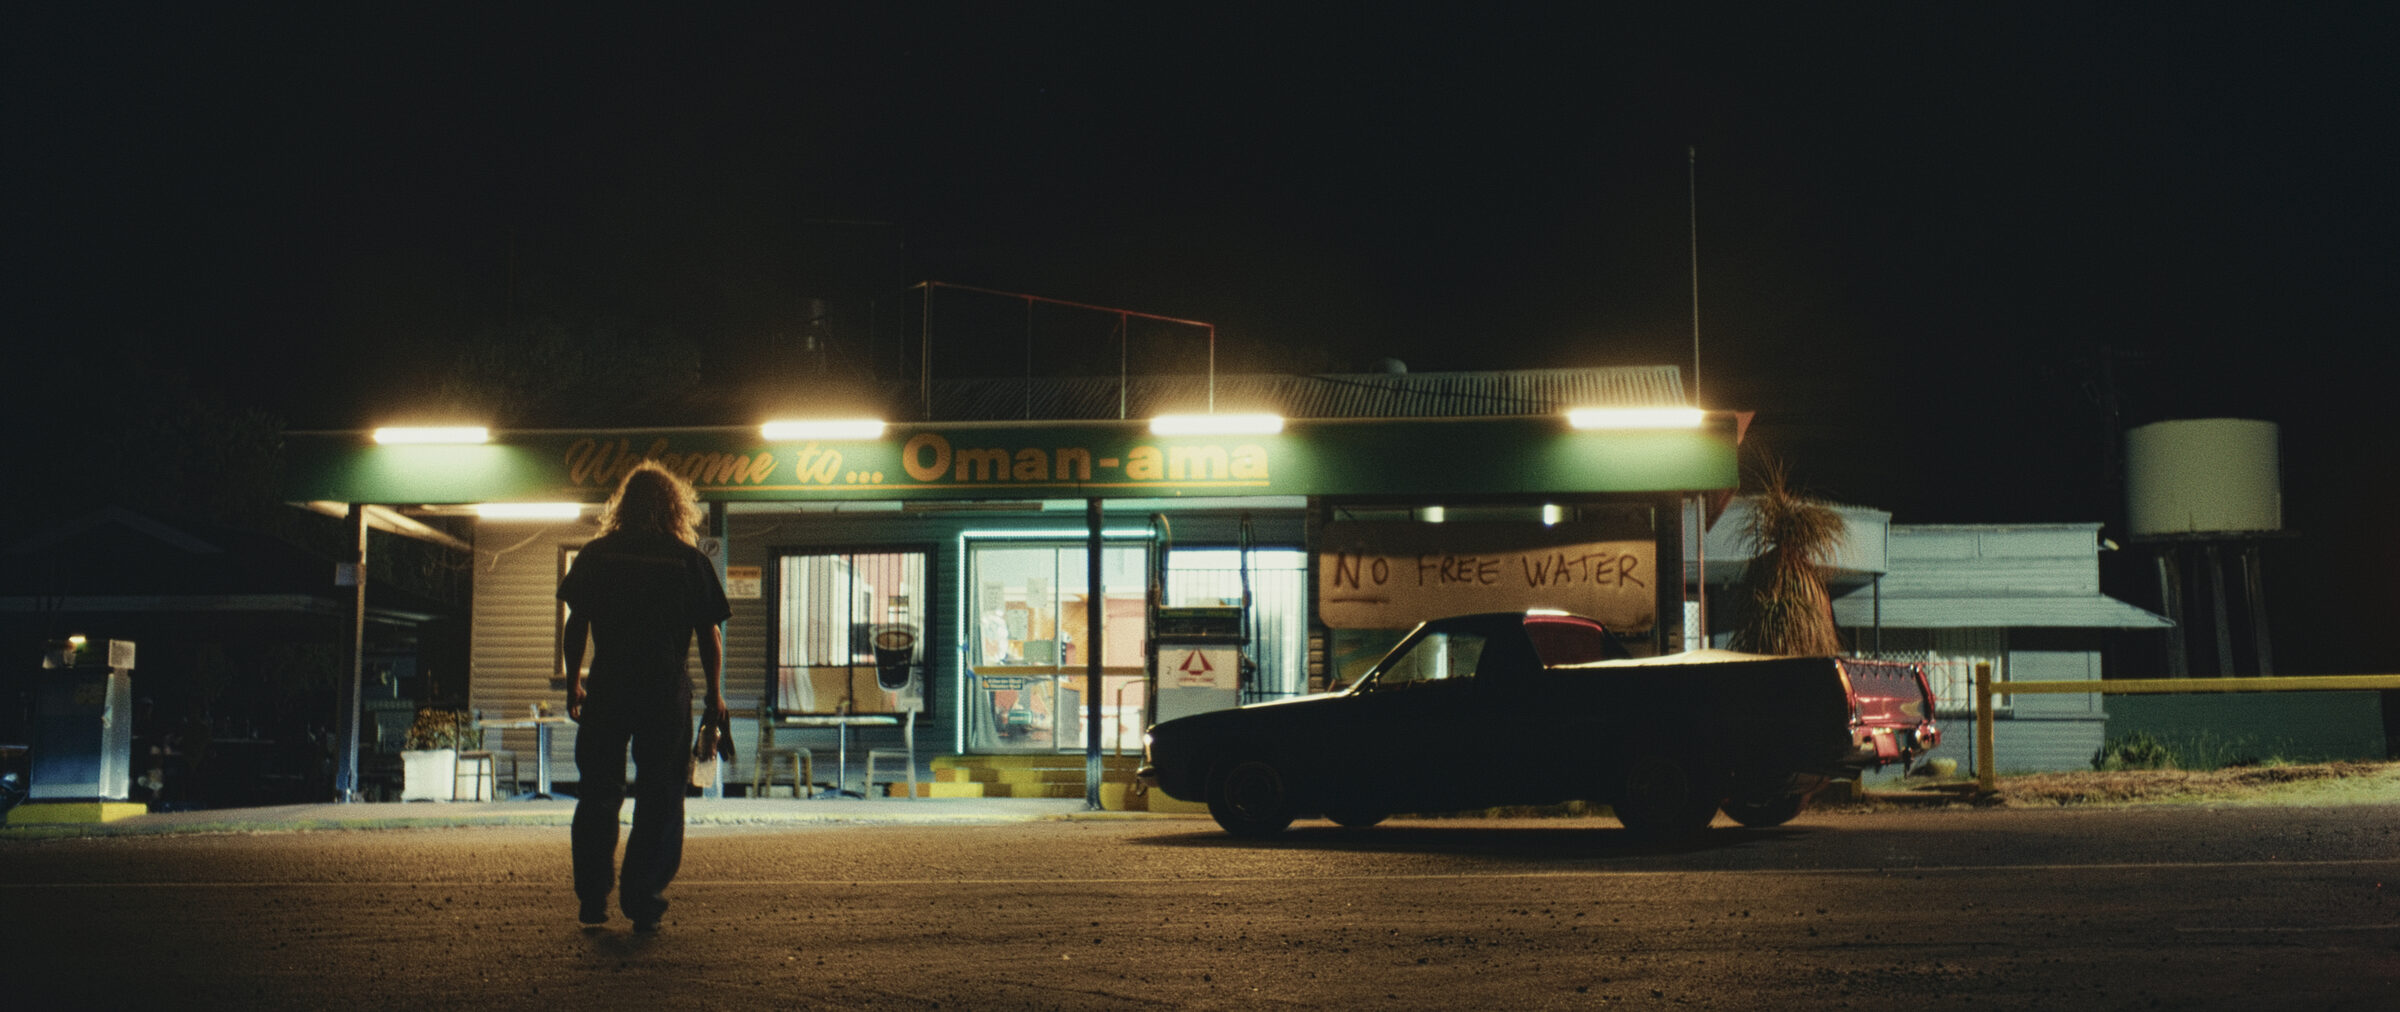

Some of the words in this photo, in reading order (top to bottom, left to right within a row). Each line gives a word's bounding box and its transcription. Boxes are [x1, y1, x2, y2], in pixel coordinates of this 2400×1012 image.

[902, 433, 1269, 482] Oman-ama
[1333, 552, 1390, 589] NO
[1417, 554, 1499, 586] FREE
[1522, 553, 1645, 589] WATER
